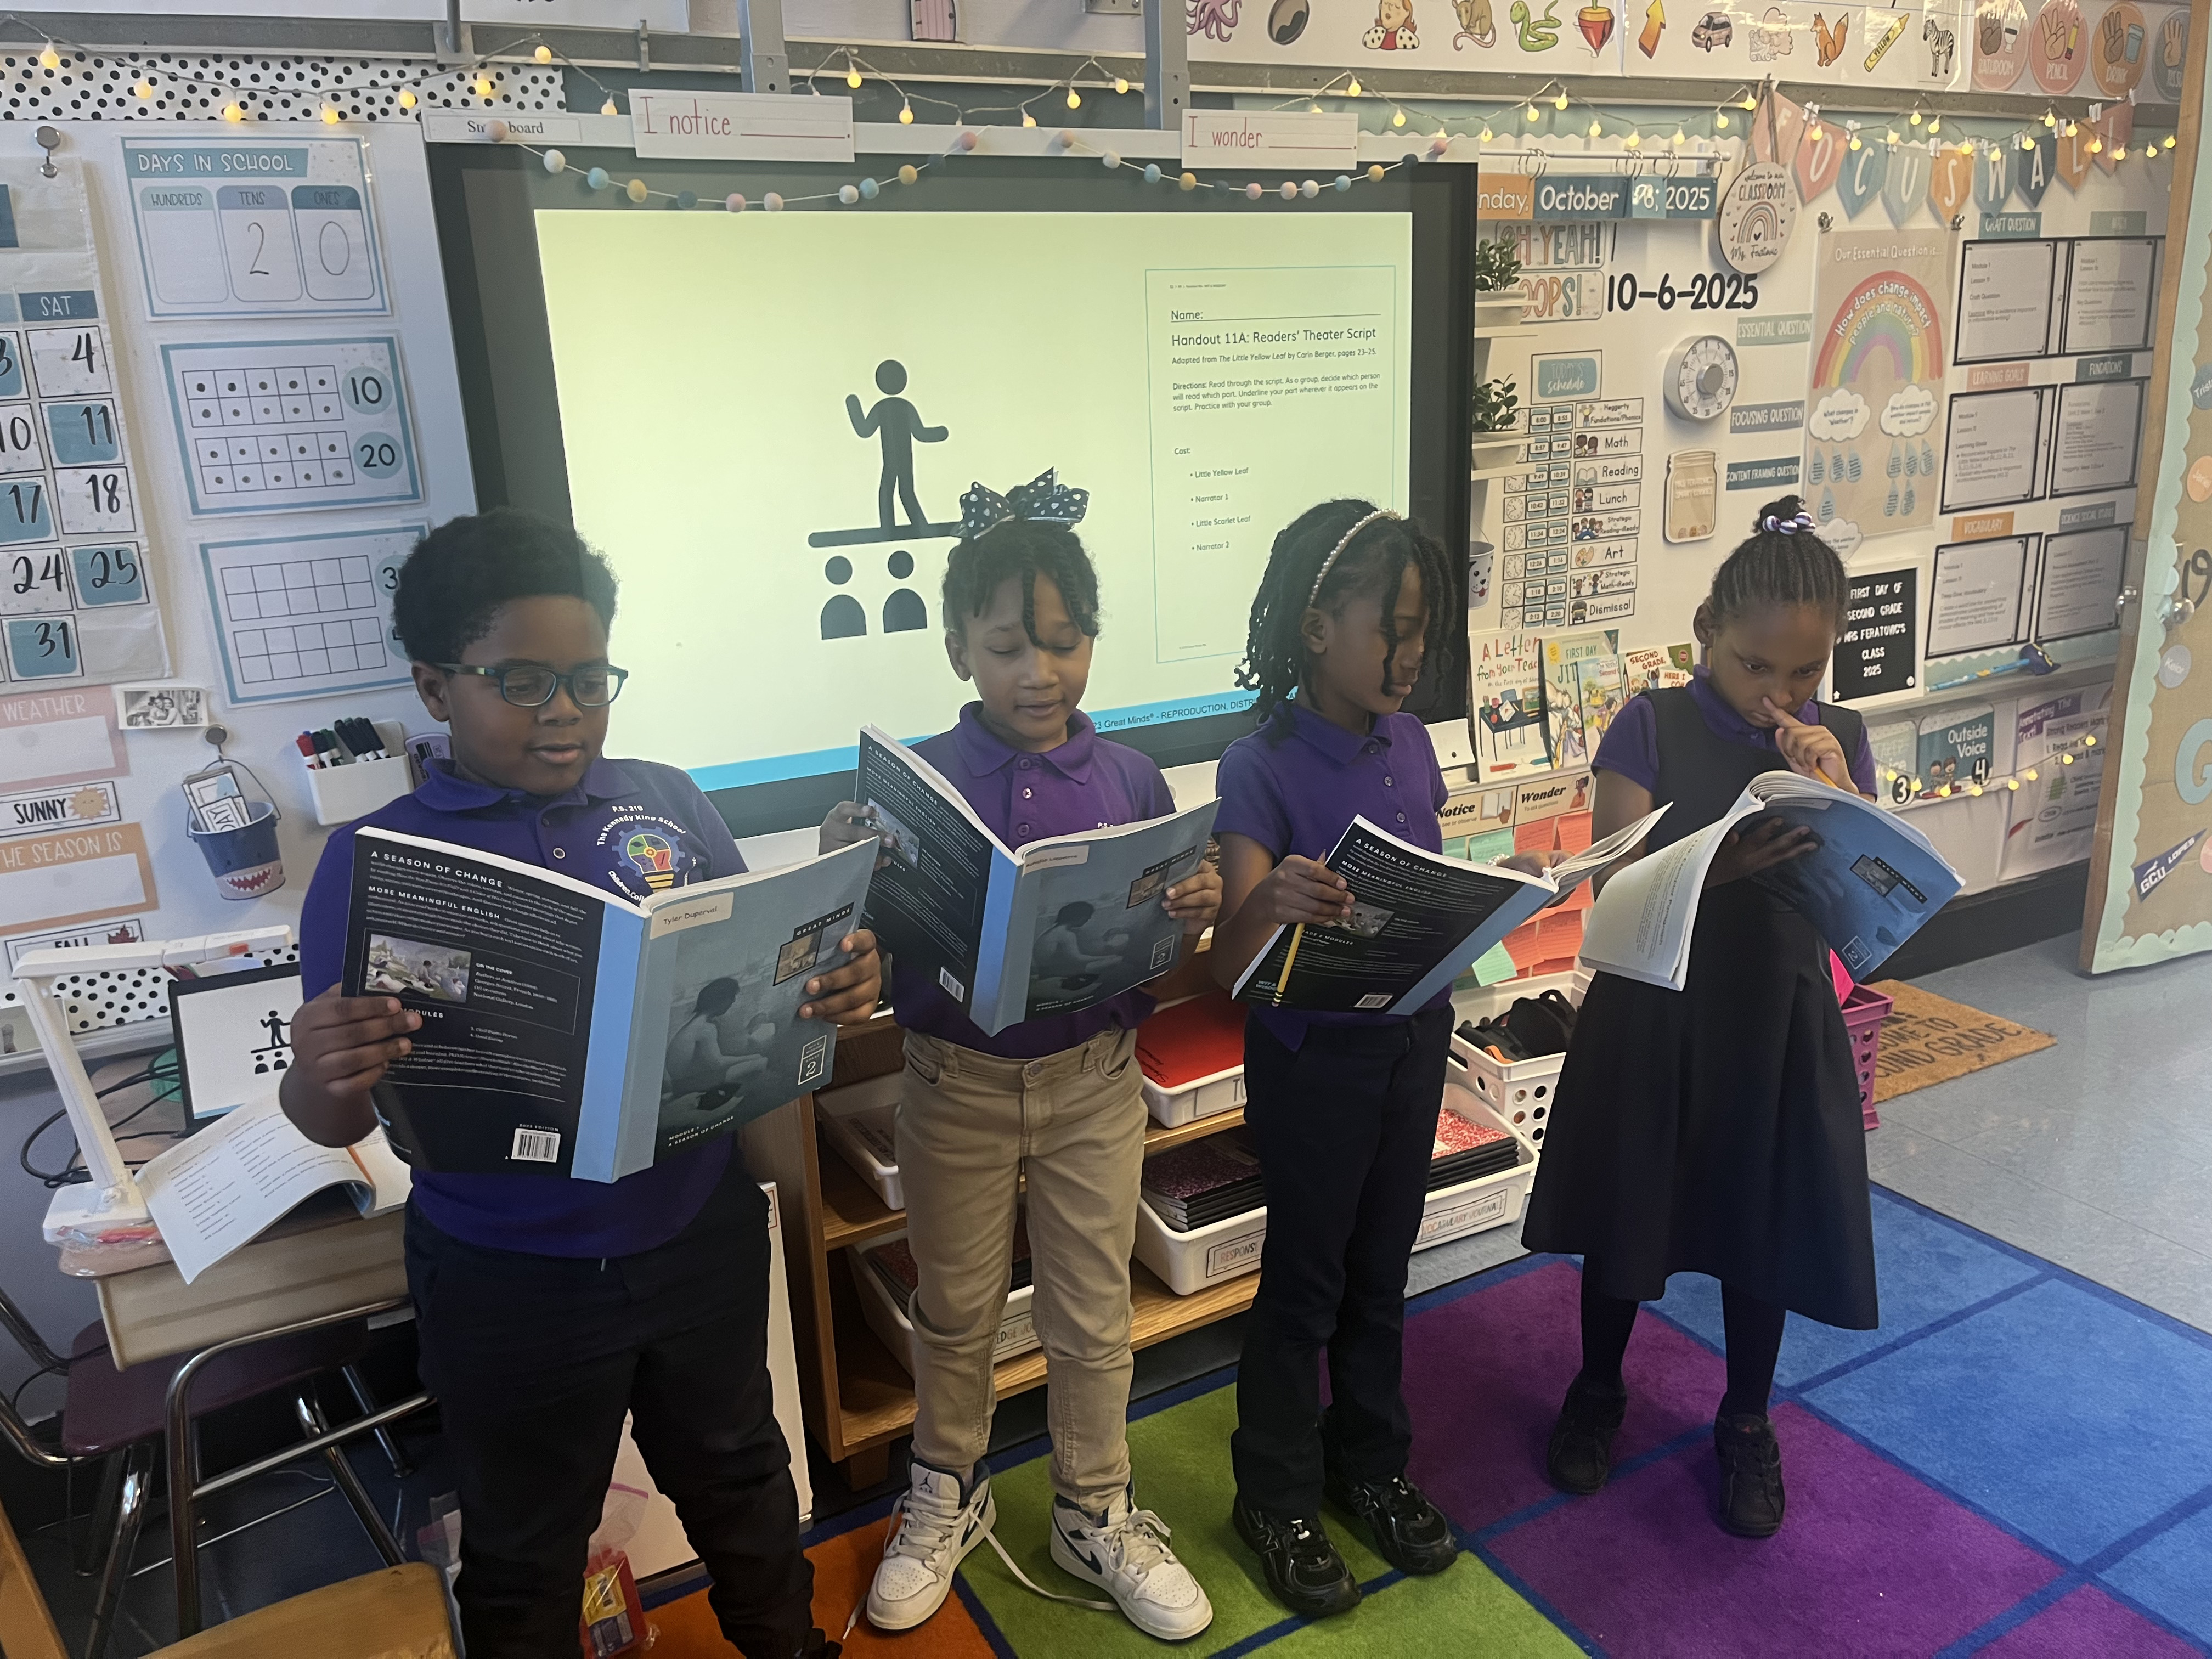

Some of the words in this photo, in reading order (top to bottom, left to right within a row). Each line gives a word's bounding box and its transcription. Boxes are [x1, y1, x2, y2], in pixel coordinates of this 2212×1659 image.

[2046, 63, 2068, 81] PENCIL
[2106, 66, 2127, 83] DRINK
[640, 96, 658, 134] I
[670, 99, 732, 136] notice
[1188, 116, 1198, 148] I
[1211, 116, 1263, 149] wonder
[138, 154, 185, 173] DAYS
[194, 154, 213, 172] IN
[221, 153, 295, 172] SCHOOL
[151, 192, 204, 207] HUNDREDS
[240, 191, 266, 206] TENS
[314, 190, 340, 206] ONES
[1539, 185, 1619, 212] October
[1664, 187, 1711, 211] 2025
[1739, 182, 1786, 202] CLASSROOM
[1985, 217, 2007, 232] CRAFT
[2007, 217, 2036, 232] QUESTION
[247, 222, 270, 276] 2
[318, 221, 351, 276] 0
[1539, 222, 1601, 266] YEAH!
[1835, 247, 1852, 261] Our
[1853, 246, 1889, 261] Essential
[1891, 246, 1928, 258] Question
[1607, 273, 1758, 312] 10-6-2025
[1171, 310, 1204, 320] Name:
[1835, 309, 1854, 337] How
[1854, 287, 1876, 310] does
[1878, 280, 1909, 298] change
[1910, 292, 1932, 329] impact
[1737, 318, 1775, 338] ESSENTIAL
[1777, 316, 1810, 336] QUESTION
[1849, 309, 1875, 345] people
[1876, 302, 1891, 314] and
[1893, 303, 1920, 336] nature?
[1172, 334, 1221, 346] Handout
[1225, 332, 1250, 345] 11A:
[1303, 330, 1345, 341] Theater
[1346, 328, 1376, 341] Script
[72, 332, 95, 374] 4
[1172, 356, 1201, 365] Adapted
[1232, 354, 1249, 362] Little
[1250, 353, 1271, 361] Yellow
[1287, 351, 1296, 360] by
[1296, 351, 1313, 359] Carin
[1314, 350, 1336, 359] Berger,
[1973, 370, 2004, 385] LEARNING
[2005, 368, 2024, 382] GOALS
[2089, 361, 2123, 376] FUNDATIONS
[1209, 380, 1226, 388] Read
[1227, 379, 1252, 388] through
[1360, 373, 1381, 381] person
[349, 376, 382, 405] 10
[1238, 389, 1268, 397] Underline
[1731, 409, 1768, 427] FOCUSING
[1770, 405, 1803, 424] QUESTION
[80, 405, 113, 447] 11
[1605, 437, 1629, 449] Math
[359, 443, 396, 467] 20
[1212, 469, 1233, 477] Yellow
[1234, 467, 1249, 475] Leaf
[1602, 464, 1639, 477] Reading
[1726, 470, 1750, 483] CONTENT
[1751, 467, 1775, 481] FRAMING
[1776, 464, 1799, 477] QUESTION
[85, 472, 121, 514] 18
[1599, 490, 1627, 505] Lunch
[9, 484, 43, 524] 17
[1214, 517, 1235, 526] Scarlet
[1964, 519, 2003, 535] VOCABULARY
[1197, 543, 1224, 551] Narrator
[1604, 545, 1624, 560] Art
[12, 554, 64, 594] 24
[89, 549, 138, 589] 25
[1850, 586, 1871, 600] FIRST
[1875, 584, 1889, 596] DAY
[1893, 582, 1903, 594] OF
[1589, 599, 1631, 615] Dismissal
[1847, 606, 1875, 622] SECOND
[1880, 602, 1903, 616] GRADE
[33, 620, 71, 659] 31
[1482, 643, 1491, 662] A
[1495, 634, 1542, 657] Letter
[1566, 647, 1583, 659] FIRST
[1585, 645, 1598, 656] DAY
[1629, 651, 1658, 665] SECOND
[1861, 647, 1886, 661] CLASS
[1477, 664, 1496, 681] from
[1496, 663, 1515, 677] your
[1599, 669, 1617, 677] Second
[1664, 672, 1679, 680] HERE
[1863, 664, 1882, 678] 2025
[2, 695, 86, 721] WEATHER
[1104, 718, 1126, 729] Great
[1161, 703, 1229, 720] REPRODUCTION,
[1948, 724, 1988, 745] Outside
[1957, 741, 1987, 759] Voice
[866, 766, 882, 781] MORE
[882, 778, 915, 808] MEANINGFUL
[874, 749, 901, 773] SEASON
[902, 772, 911, 781] OF
[912, 780, 939, 806] CHANGE
[1521, 786, 1567, 804] Wonder
[1538, 799, 1559, 810] questions
[13, 797, 67, 825] SUNNY
[1436, 803, 1476, 819] Notice
[1458, 816, 1478, 825] observe
[596, 831, 607, 846] The
[602, 815, 634, 833] Kennedy
[658, 817, 687, 835] School
[31, 836, 103, 865] SEASON
[108, 832, 123, 853] IS
[1363, 842, 1398, 862] SEASON
[1413, 865, 1448, 878] CHANGE
[2140, 866, 2166, 895] GCU
[2168, 837, 2195, 864] LOPES
[383, 853, 430, 870] SEASON
[436, 865, 451, 873] OF
[455, 869, 503, 888] CHANGE
[1341, 860, 1361, 873] MORE
[1361, 871, 1403, 889] MEANINGFUL
[368, 885, 394, 896] MORE
[398, 891, 458, 910] MEANINGFUL
[461, 905, 500, 919] ENGLISH
[663, 915, 682, 926] Tyler
[684, 906, 718, 920] Duperval
[796, 921, 822, 936] GREAT
[826, 907, 850, 923] MINDS
[1324, 935, 1354, 946] MODULES
[495, 966, 513, 975] COVER
[1925, 1022, 2023, 1057] GRADE
[805, 1060, 817, 1077] 2
[669, 1127, 695, 1141] MODULE
